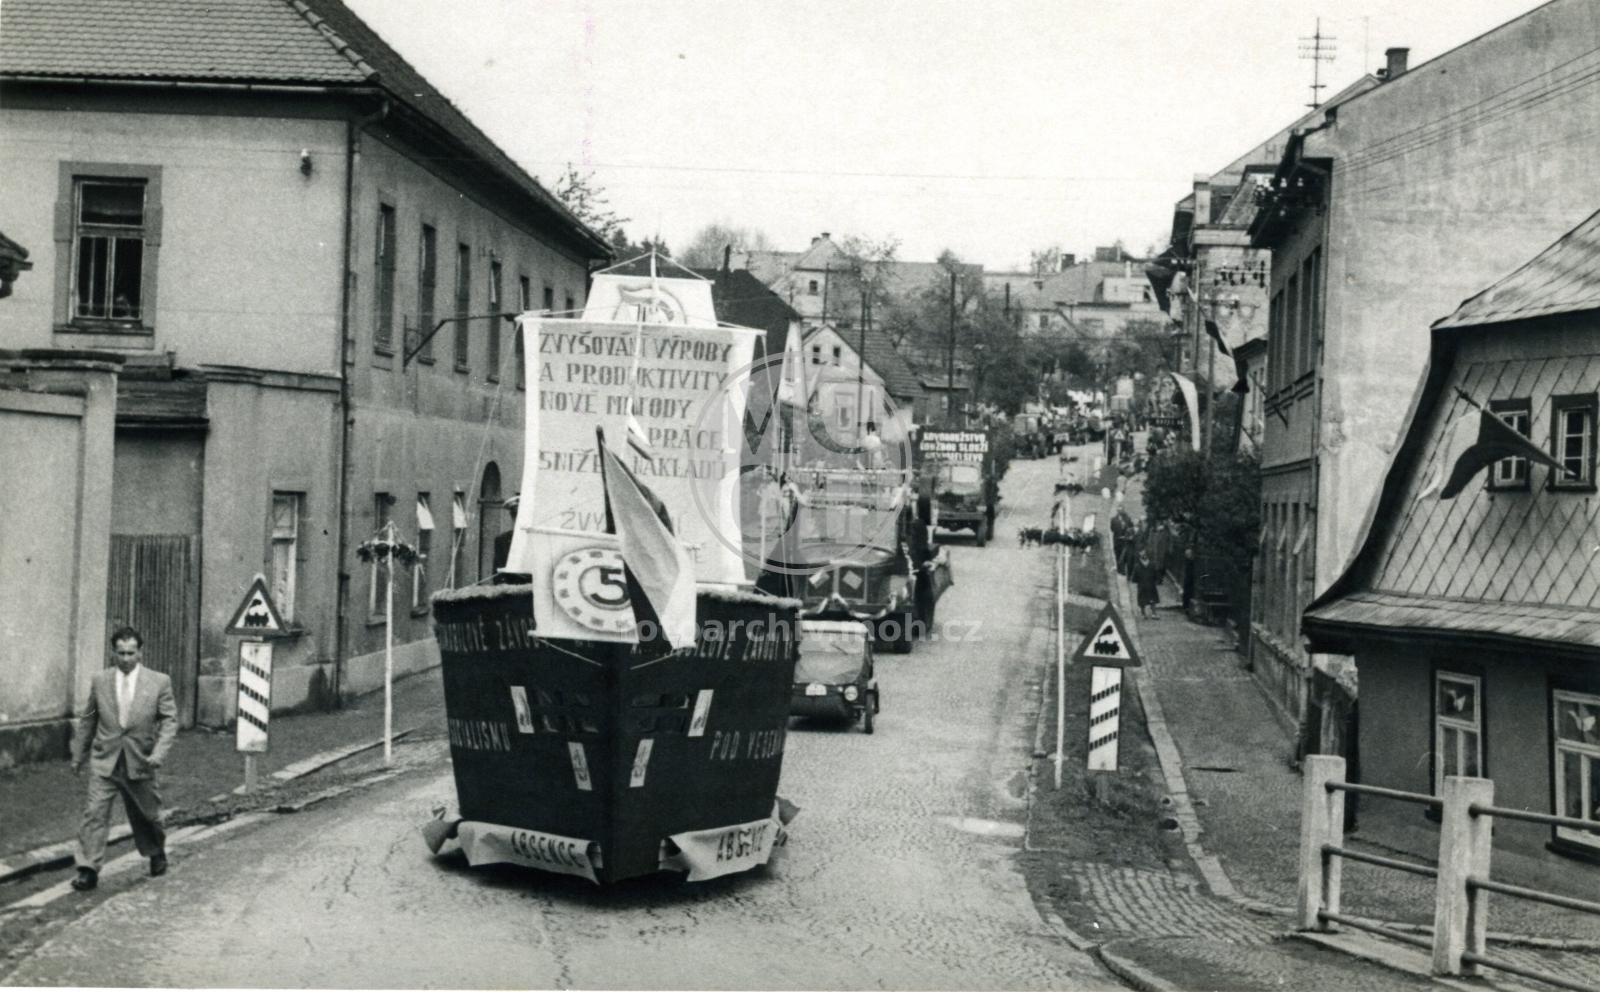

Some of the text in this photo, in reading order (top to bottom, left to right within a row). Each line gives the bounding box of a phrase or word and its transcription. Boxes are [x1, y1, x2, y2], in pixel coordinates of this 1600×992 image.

[538, 330, 733, 363] ZVYŠOVÁNÍ VÝROBY
[539, 363, 554, 383] A
[538, 389, 598, 414] NOVÉ
[709, 730, 740, 760] POD
